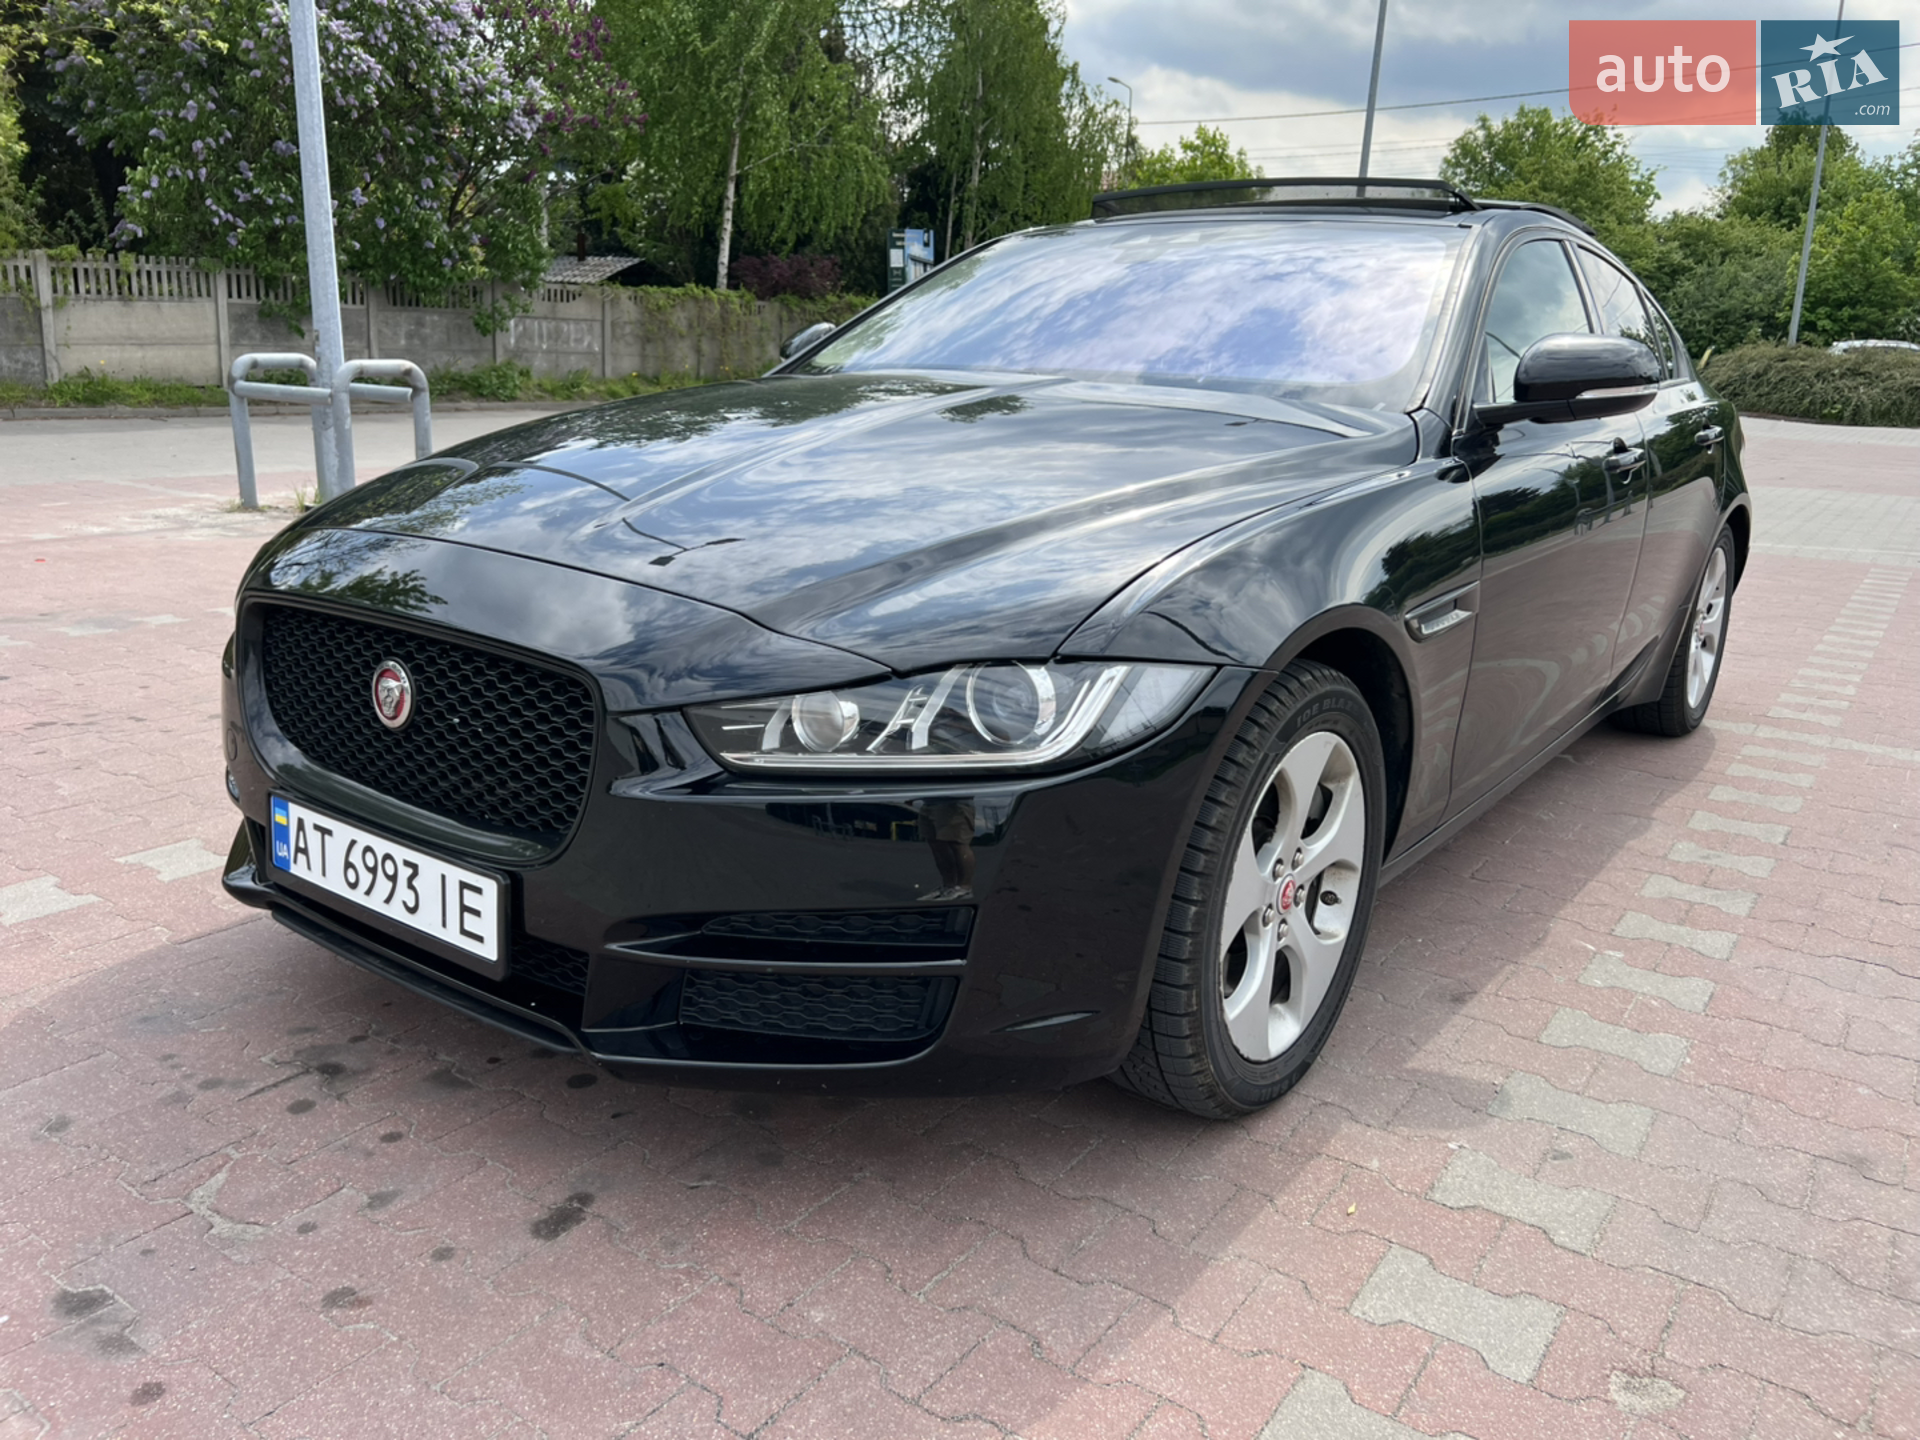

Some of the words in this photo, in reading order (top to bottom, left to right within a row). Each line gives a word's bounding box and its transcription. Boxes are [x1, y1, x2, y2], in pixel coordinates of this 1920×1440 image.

[275, 840, 290, 860] UA
[293, 816, 334, 878] AT
[343, 839, 420, 915] 6993
[441, 872, 485, 944] IE
